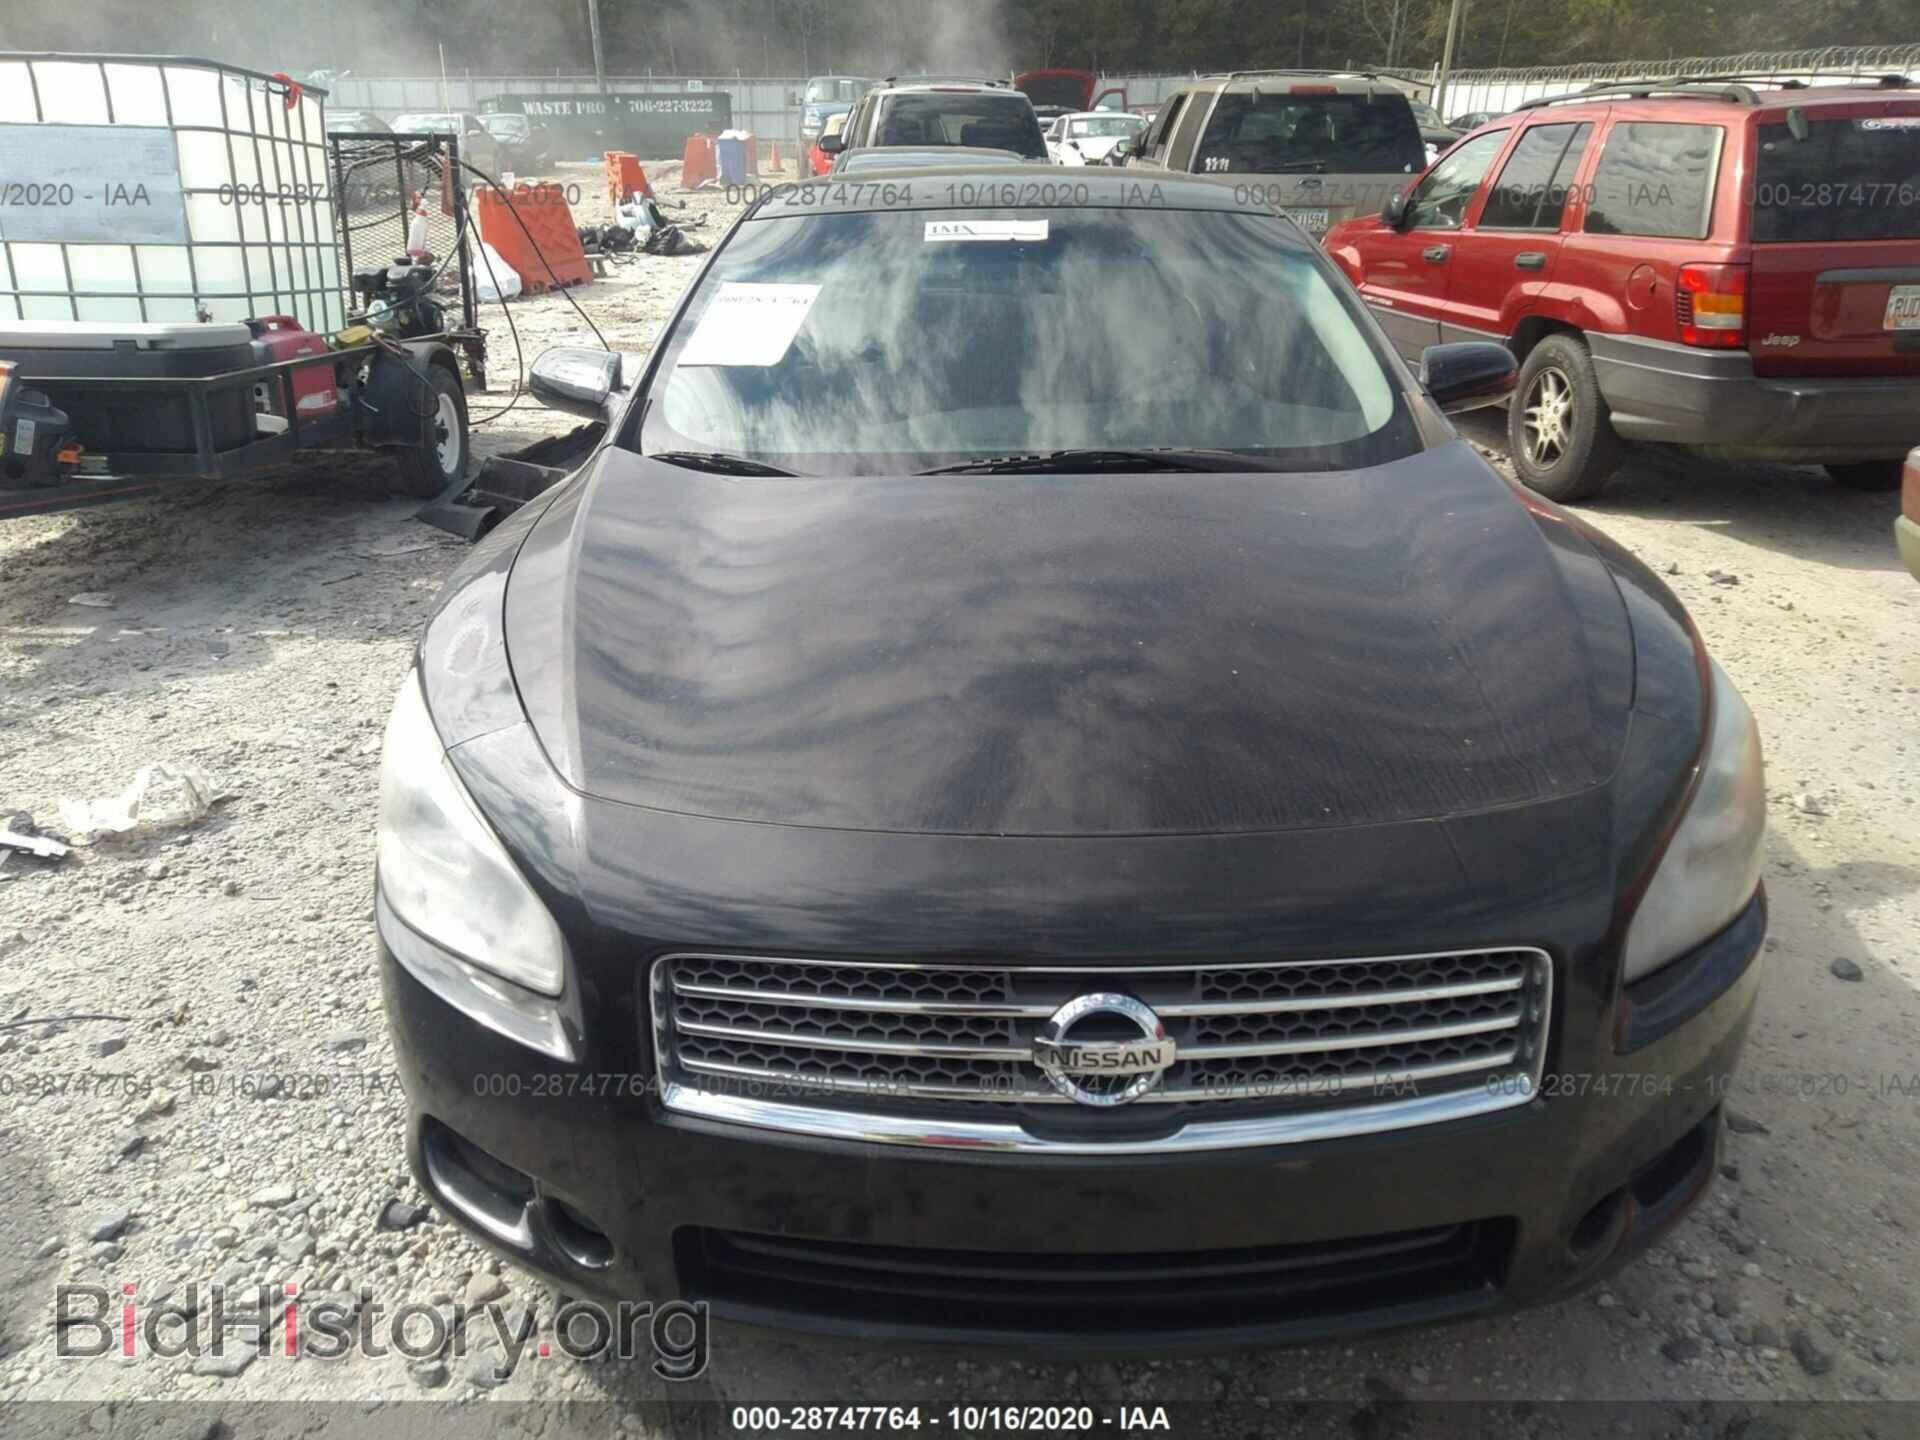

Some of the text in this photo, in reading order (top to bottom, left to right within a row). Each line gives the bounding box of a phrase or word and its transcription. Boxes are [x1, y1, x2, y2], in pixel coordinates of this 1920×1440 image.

[522, 101, 606, 116] WASTE PRO
[629, 99, 713, 113] 706-227-3222
[1761, 333, 1800, 347] Jeep
[1049, 1048, 1162, 1069] NISSAN
